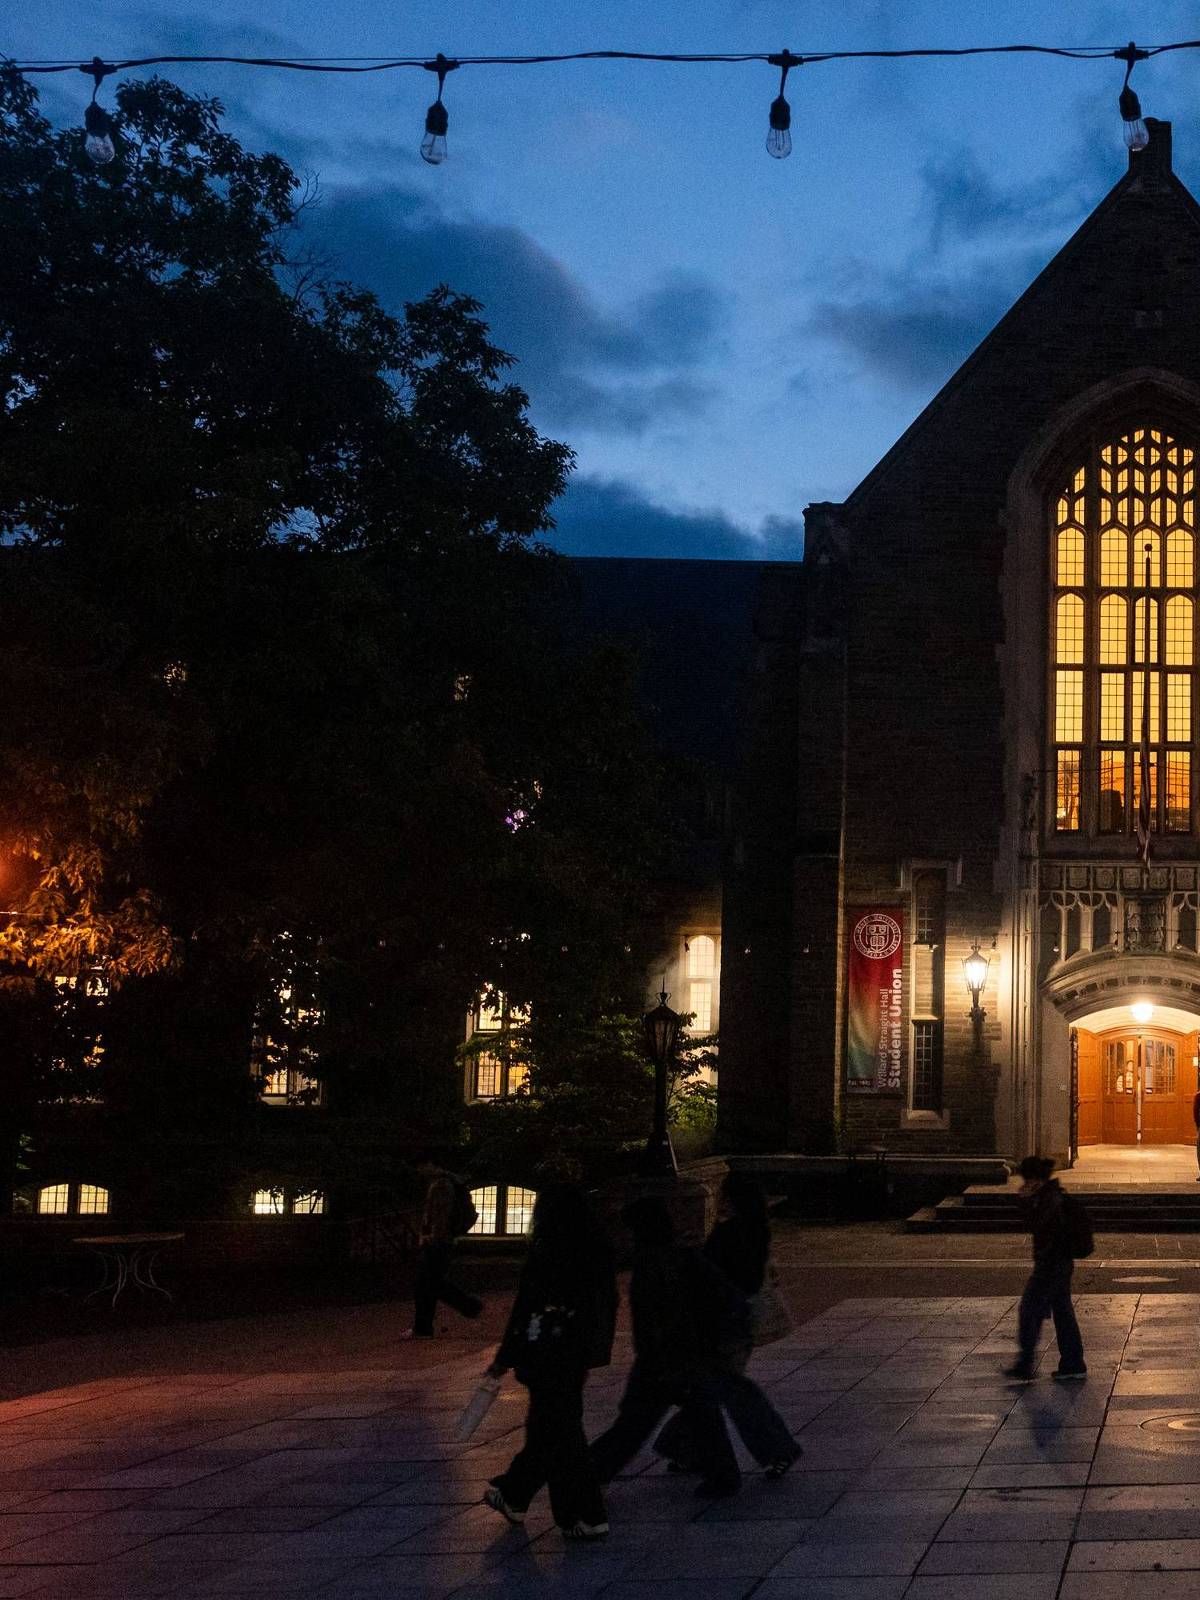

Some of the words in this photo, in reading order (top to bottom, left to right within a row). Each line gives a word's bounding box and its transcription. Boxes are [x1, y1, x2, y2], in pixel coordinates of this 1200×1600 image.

[879, 988, 889, 1008] Hall
[888, 968, 902, 1017] Union
[878, 1010, 890, 1050] Straight
[877, 1052, 888, 1088] Willard
[888, 1021, 902, 1088] Student
